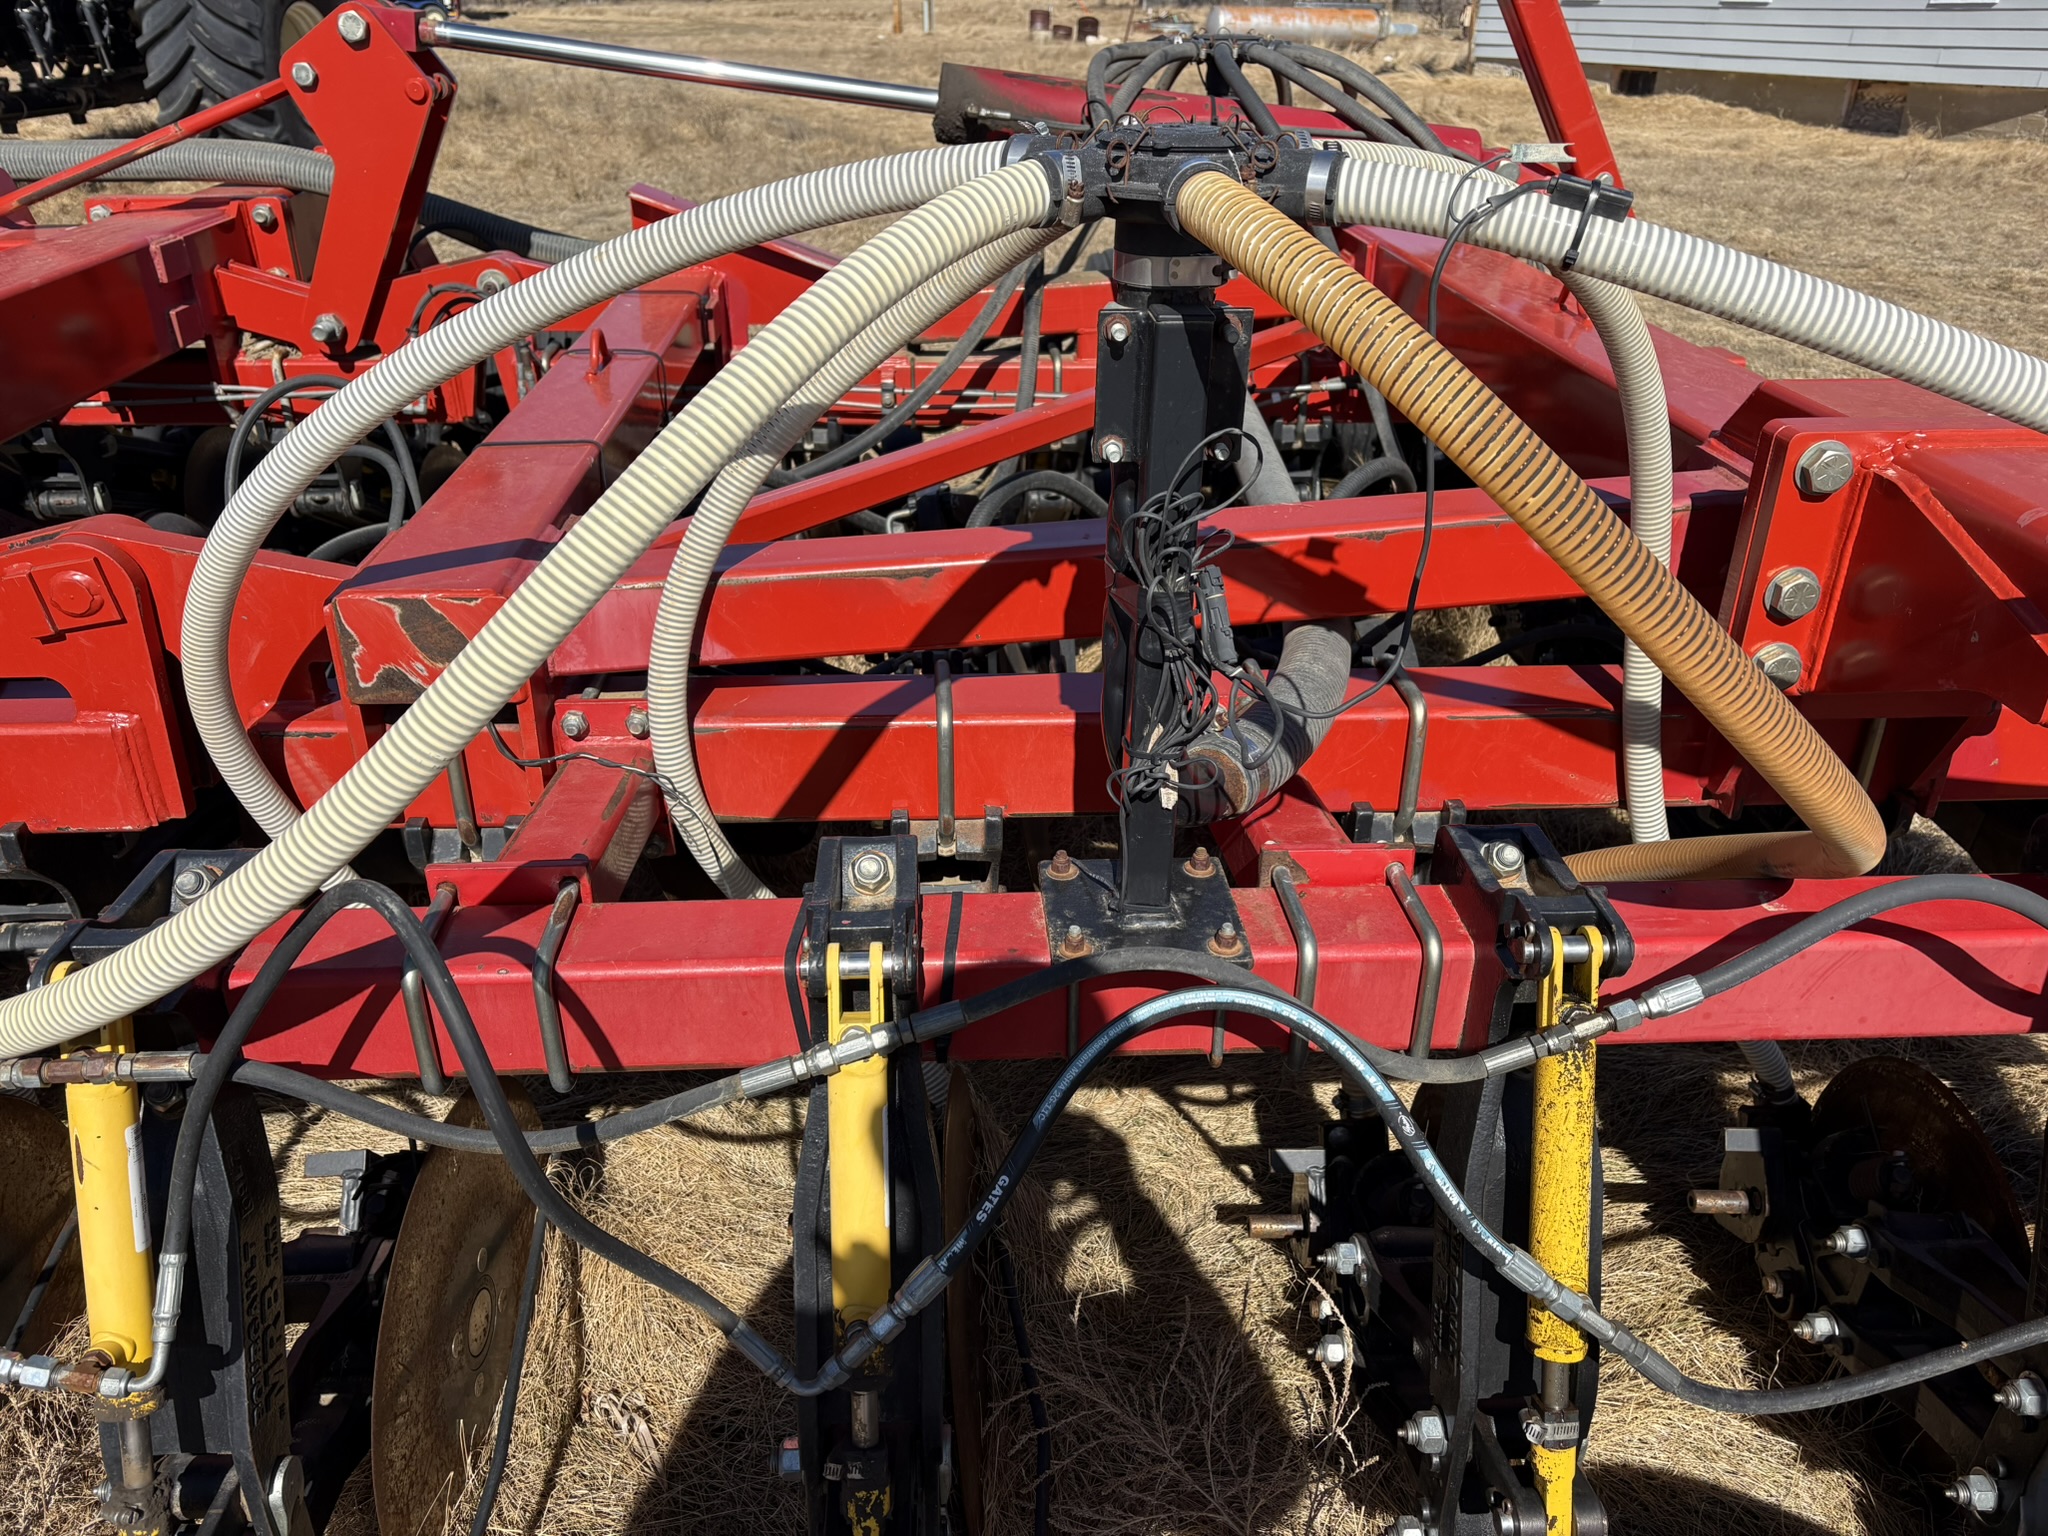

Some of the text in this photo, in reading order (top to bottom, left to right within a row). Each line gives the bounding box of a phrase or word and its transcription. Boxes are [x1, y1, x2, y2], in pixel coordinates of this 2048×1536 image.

[1107, 1018, 1133, 1038] Flame
[1076, 1035, 1108, 1067] Resistant
[1344, 1051, 1365, 1071] 4800
[1058, 1066, 1079, 1091] MSHA
[1038, 1090, 1061, 1121] 2G-11C
[975, 1174, 1009, 1223] GATES
